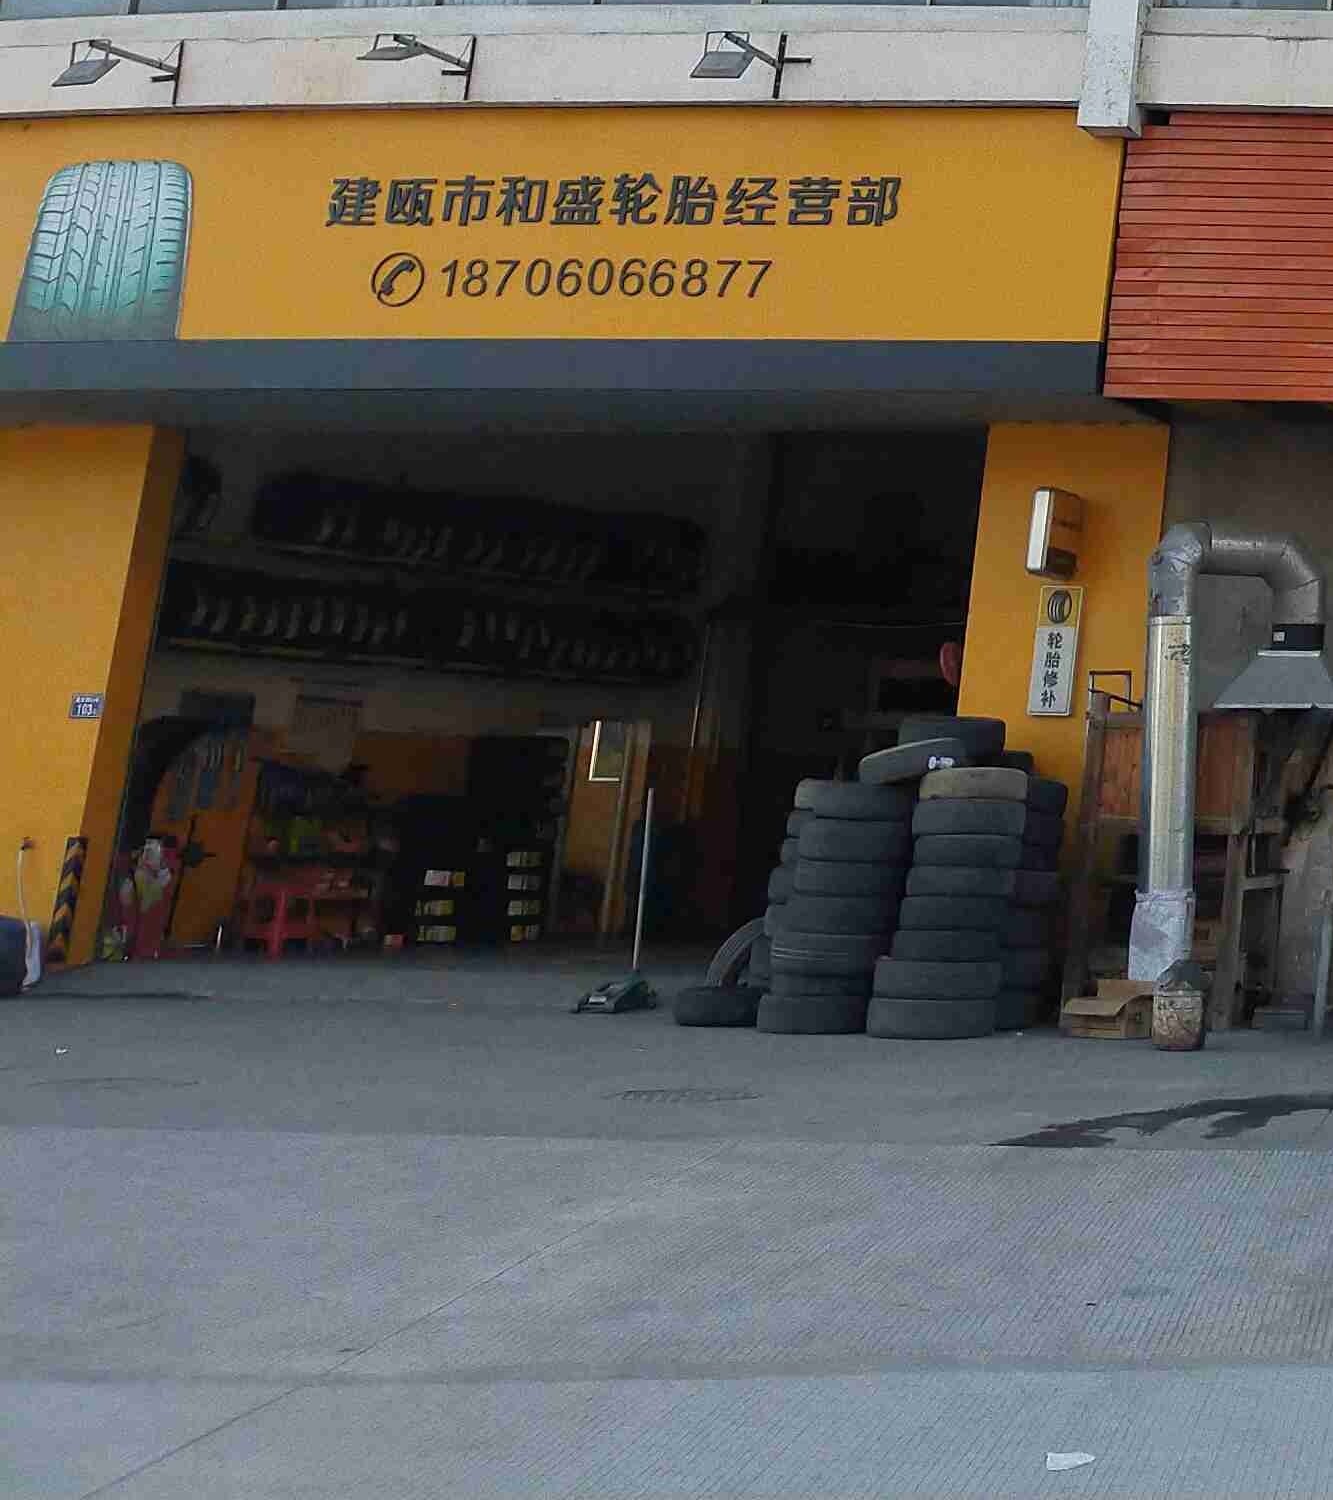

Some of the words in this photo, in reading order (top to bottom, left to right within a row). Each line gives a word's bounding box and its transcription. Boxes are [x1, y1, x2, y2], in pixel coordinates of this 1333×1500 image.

[325, 173, 902, 228] 建瓯市和盛轮胎经营部
[441, 257, 774, 300] 18706066877
[1041, 631, 1064, 709] 轮胎修补
